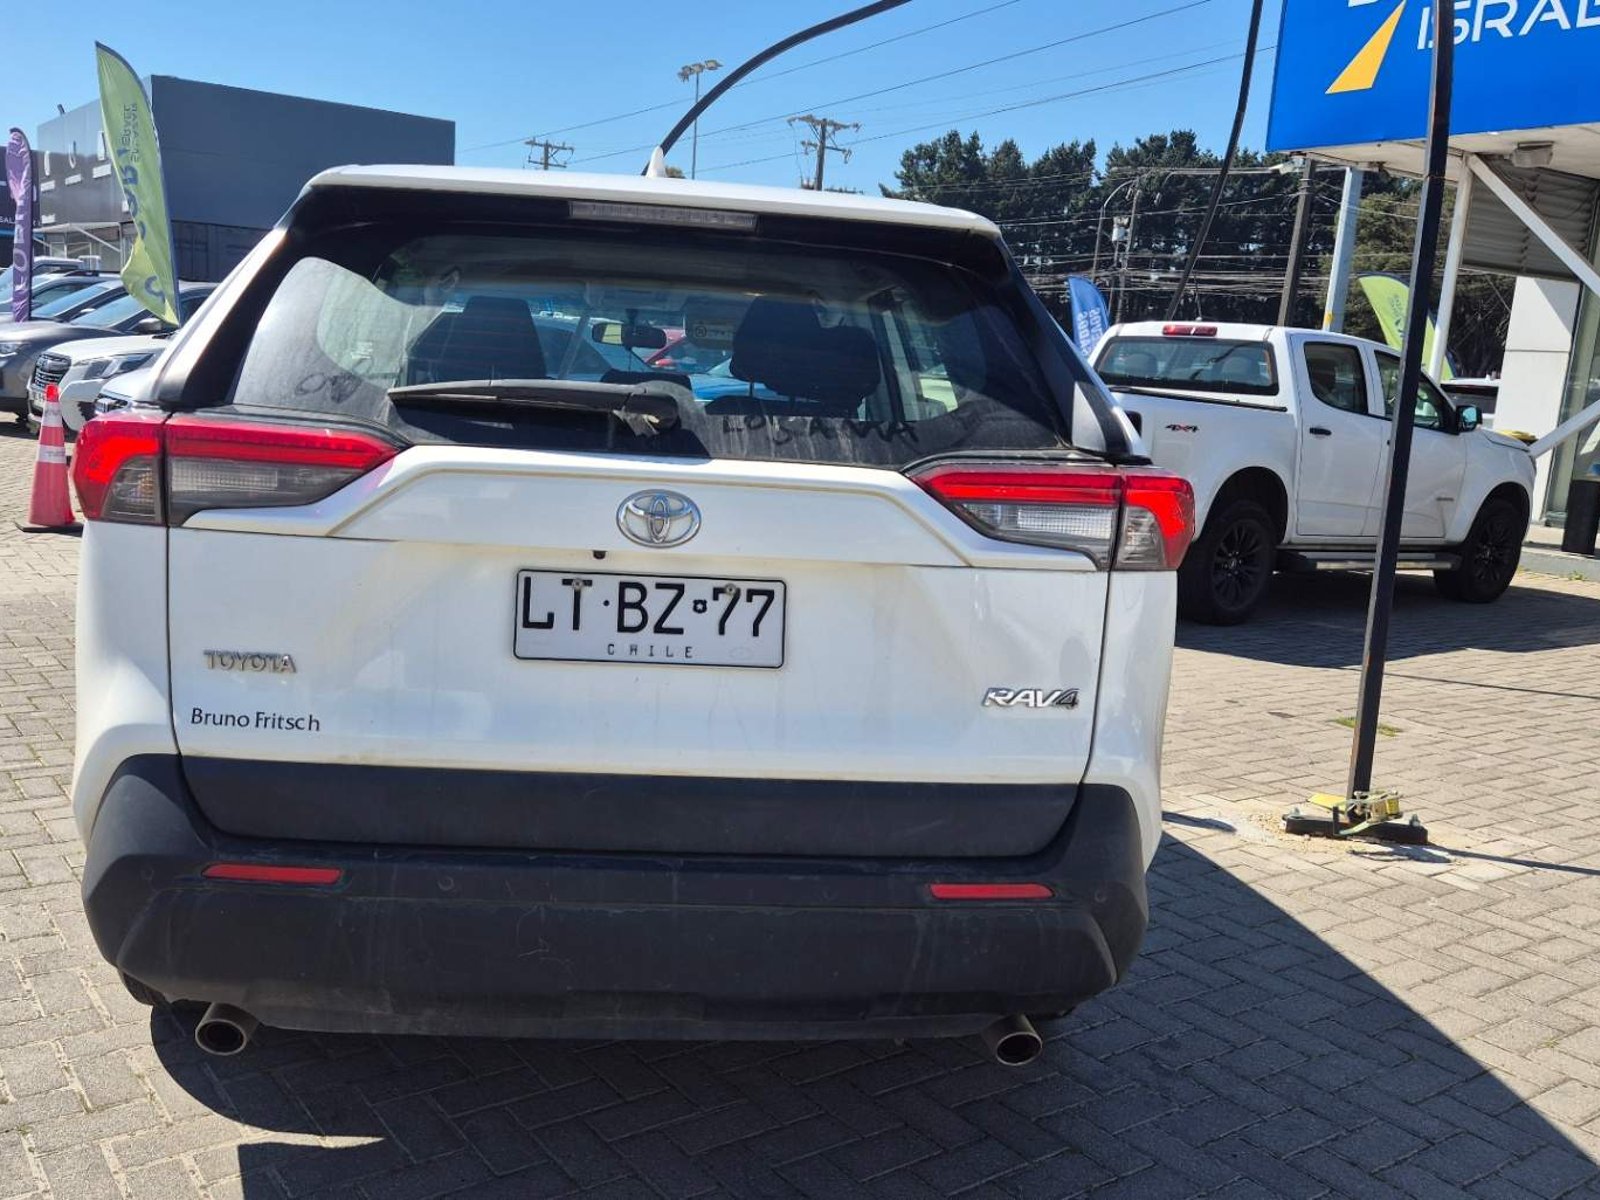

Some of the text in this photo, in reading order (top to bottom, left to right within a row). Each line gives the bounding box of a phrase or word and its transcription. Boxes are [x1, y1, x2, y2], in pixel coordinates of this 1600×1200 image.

[203, 650, 297, 673] TOYOTA
[606, 643, 693, 659] CHILE
[982, 687, 1080, 709] RAV4
[190, 707, 321, 732] Bruno Fritsch
